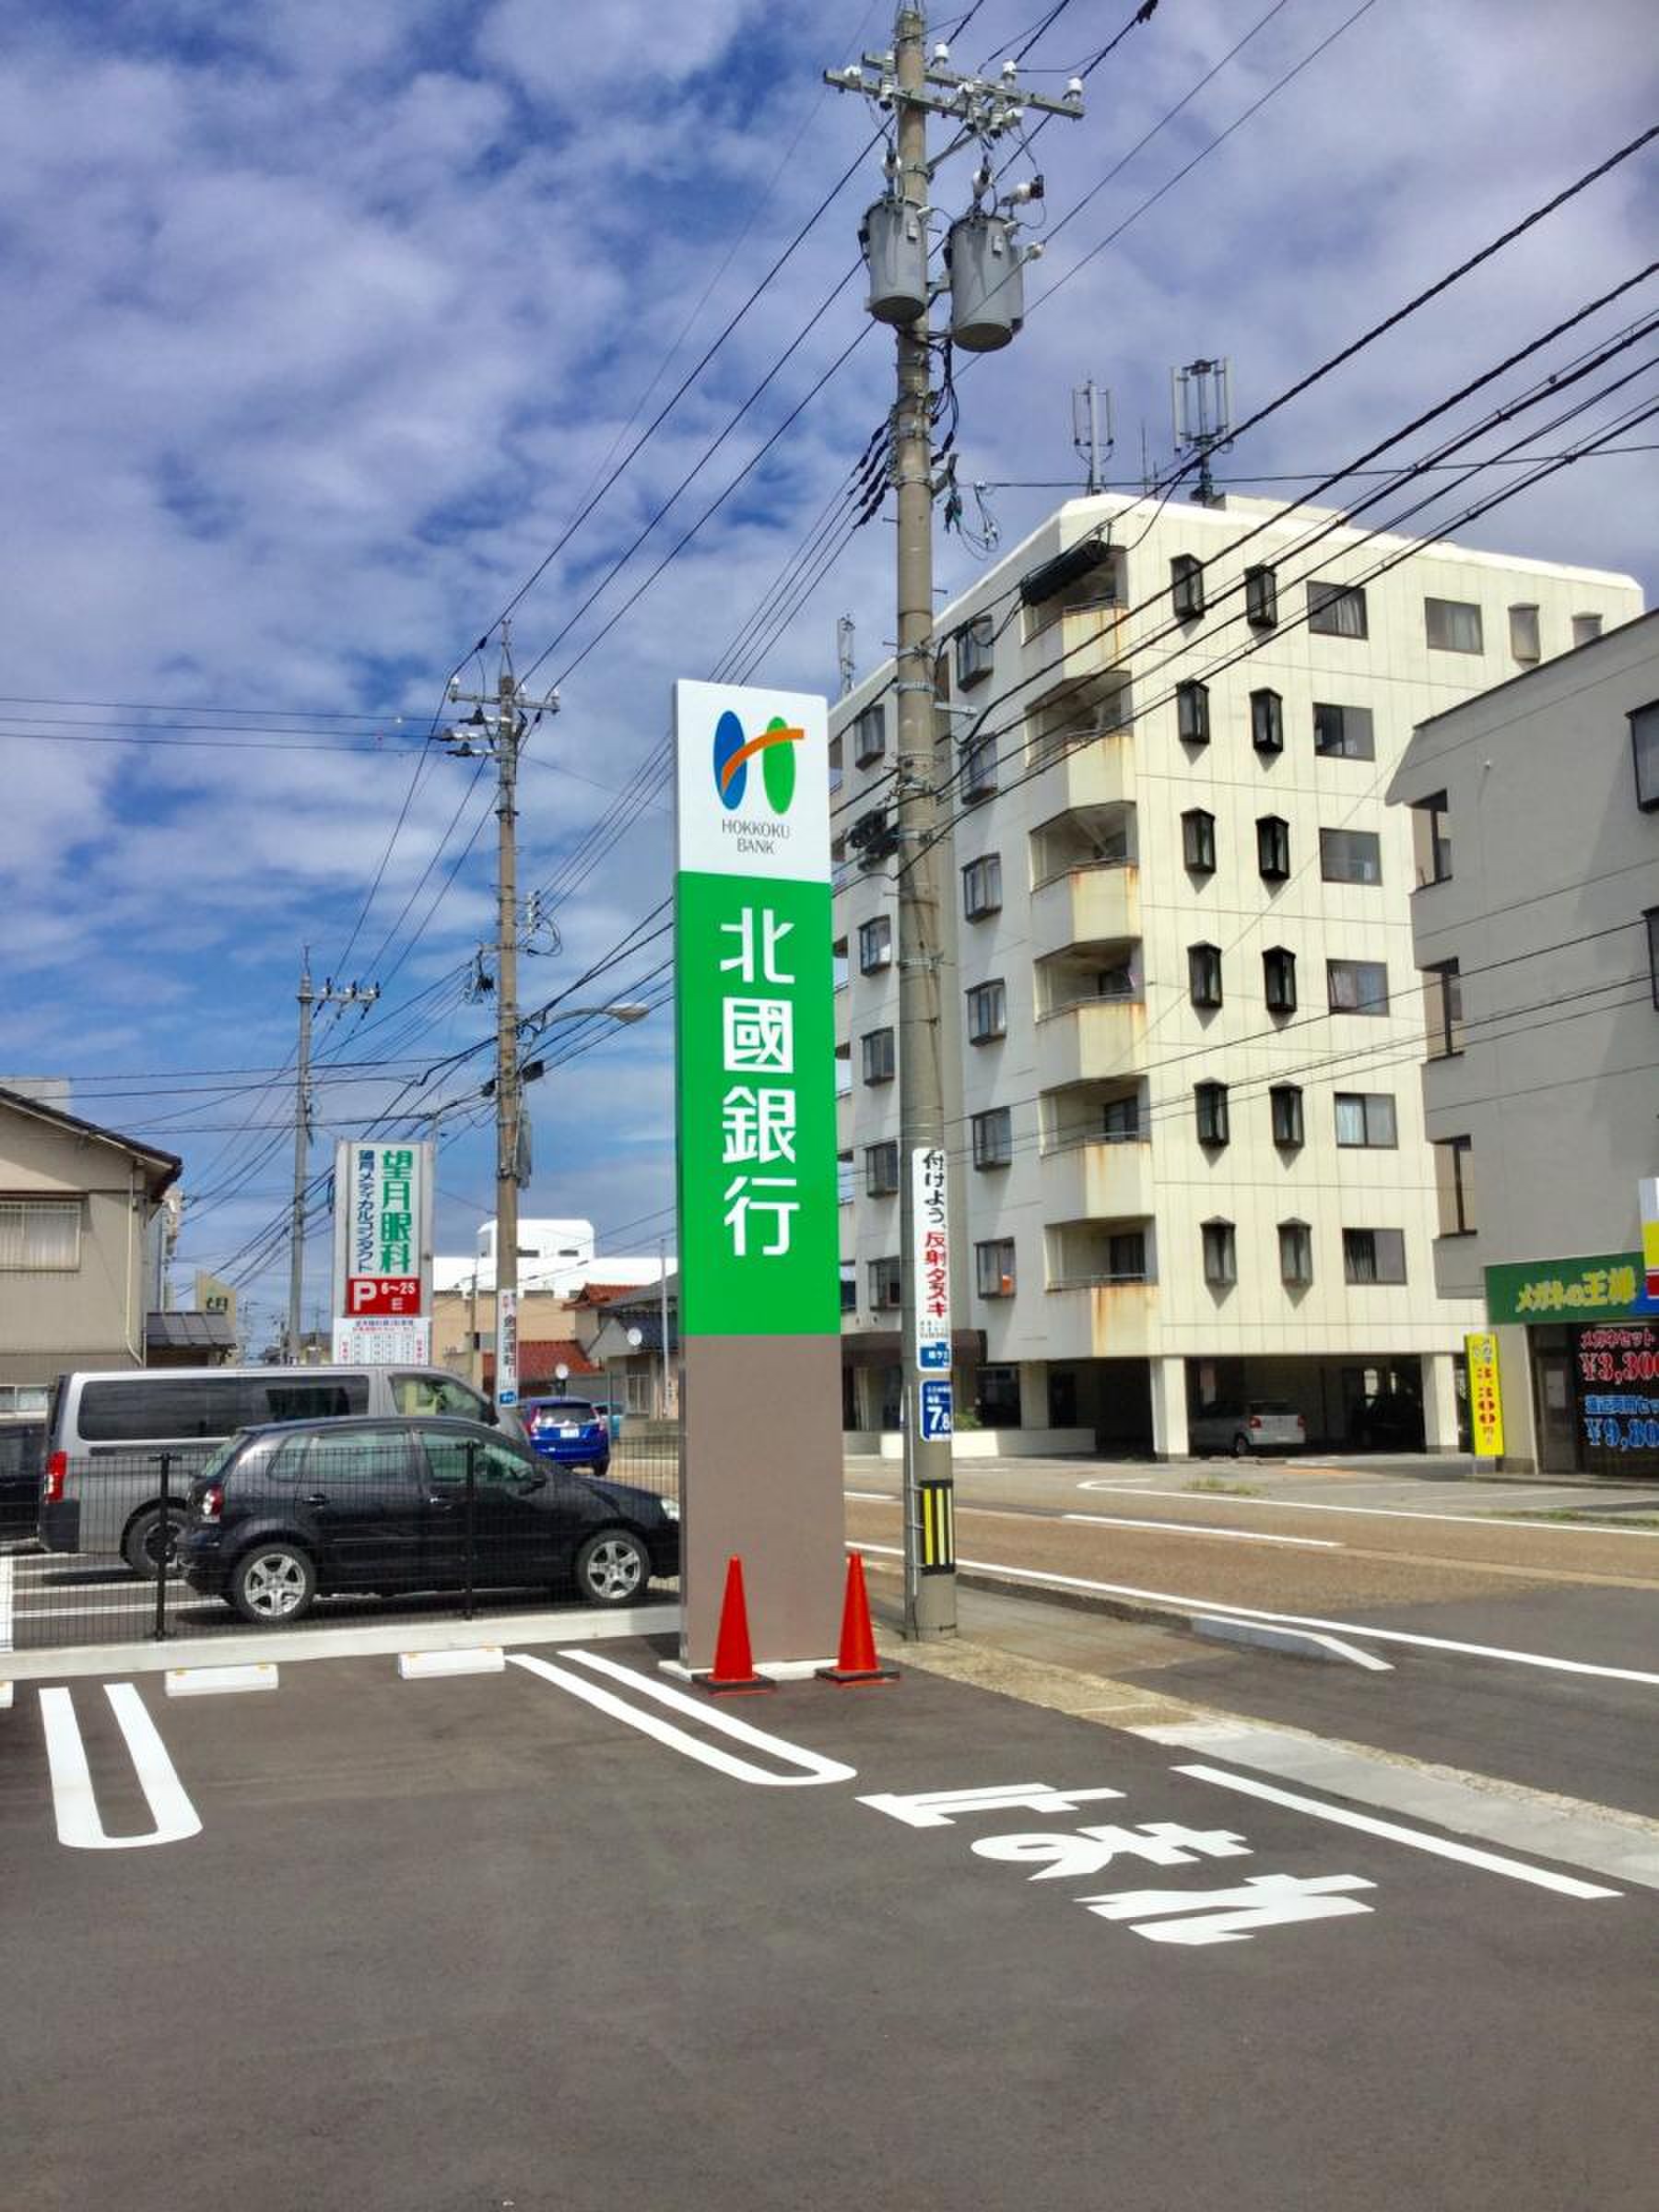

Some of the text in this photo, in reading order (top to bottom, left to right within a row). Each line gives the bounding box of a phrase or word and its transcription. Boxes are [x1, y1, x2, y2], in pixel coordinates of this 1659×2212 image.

[722, 818, 791, 840] HOKKOKU
[736, 837, 775, 855] BANK
[720, 906, 801, 1258] 北國銀行
[381, 1149, 414, 1274] 望月眼科
[353, 1281, 377, 1312] P
[855, 1783, 1378, 1946] 止まれ
